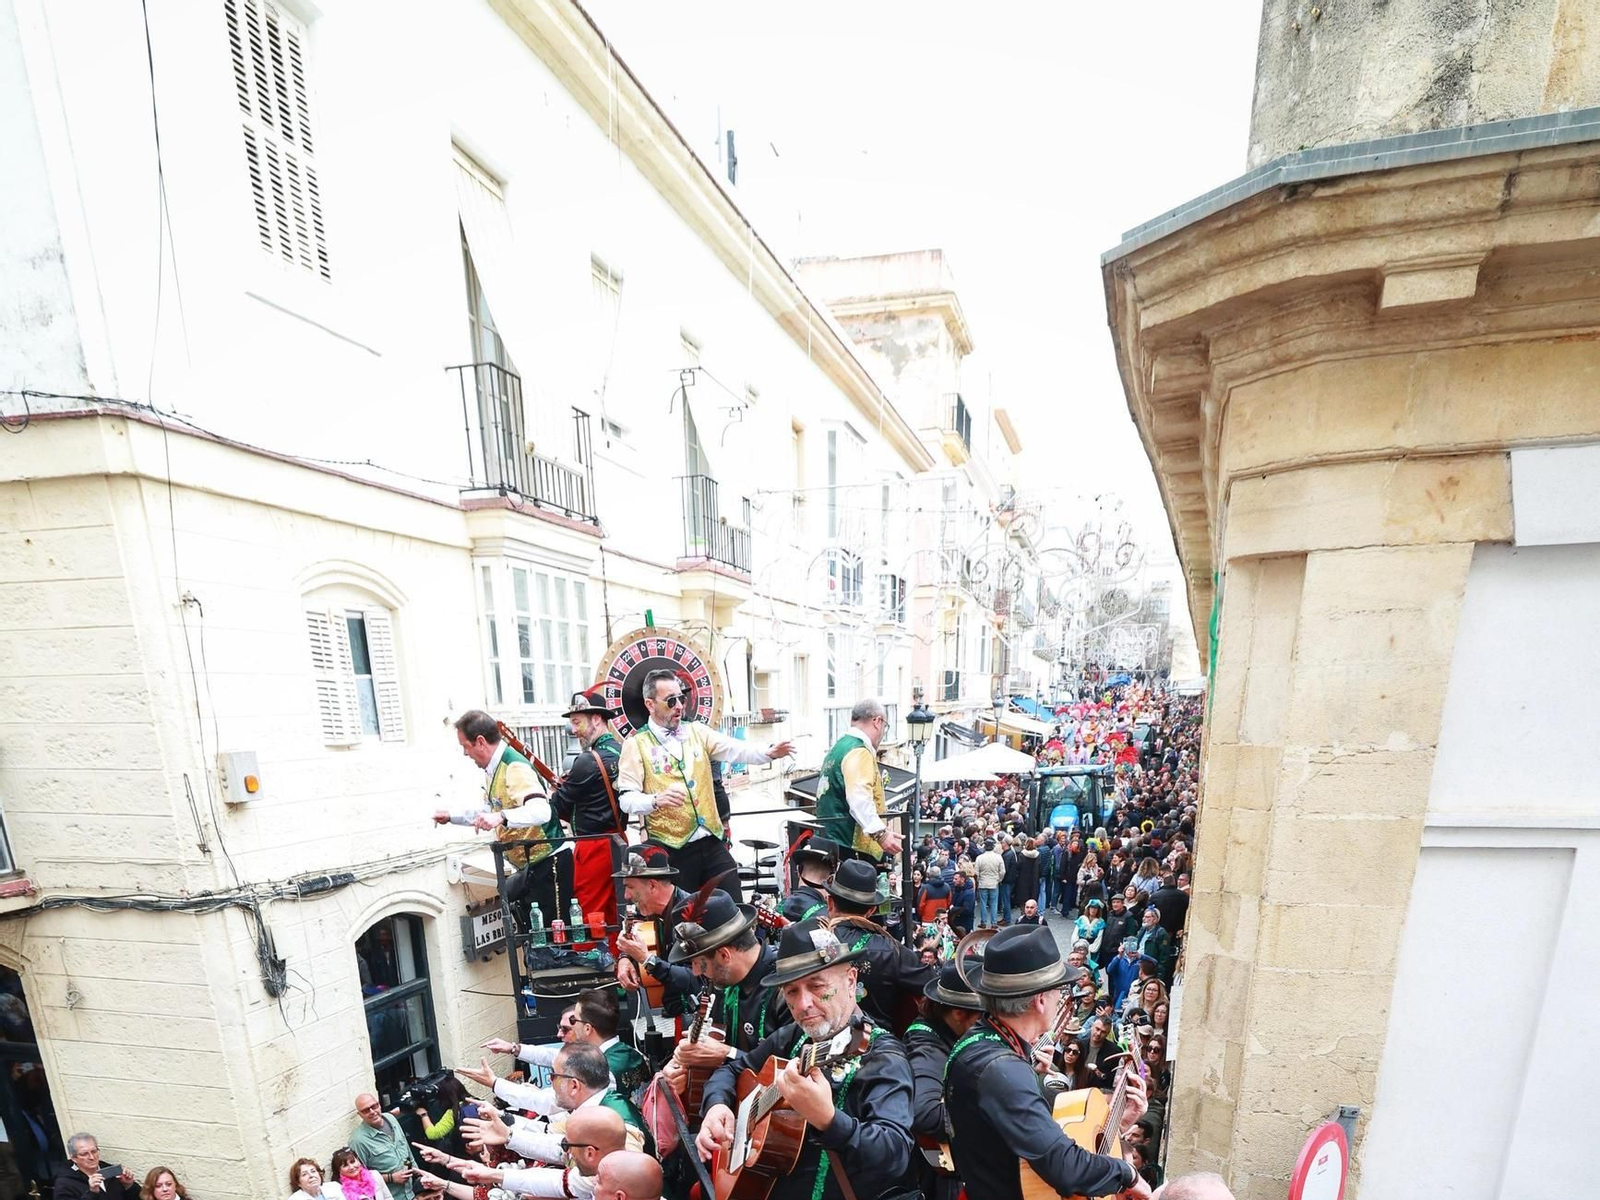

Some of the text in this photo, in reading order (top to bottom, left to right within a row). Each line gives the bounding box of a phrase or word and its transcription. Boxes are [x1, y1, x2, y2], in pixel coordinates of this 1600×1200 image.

[481, 910, 502, 926] MESO
[476, 923, 517, 947] LAS BRIS
